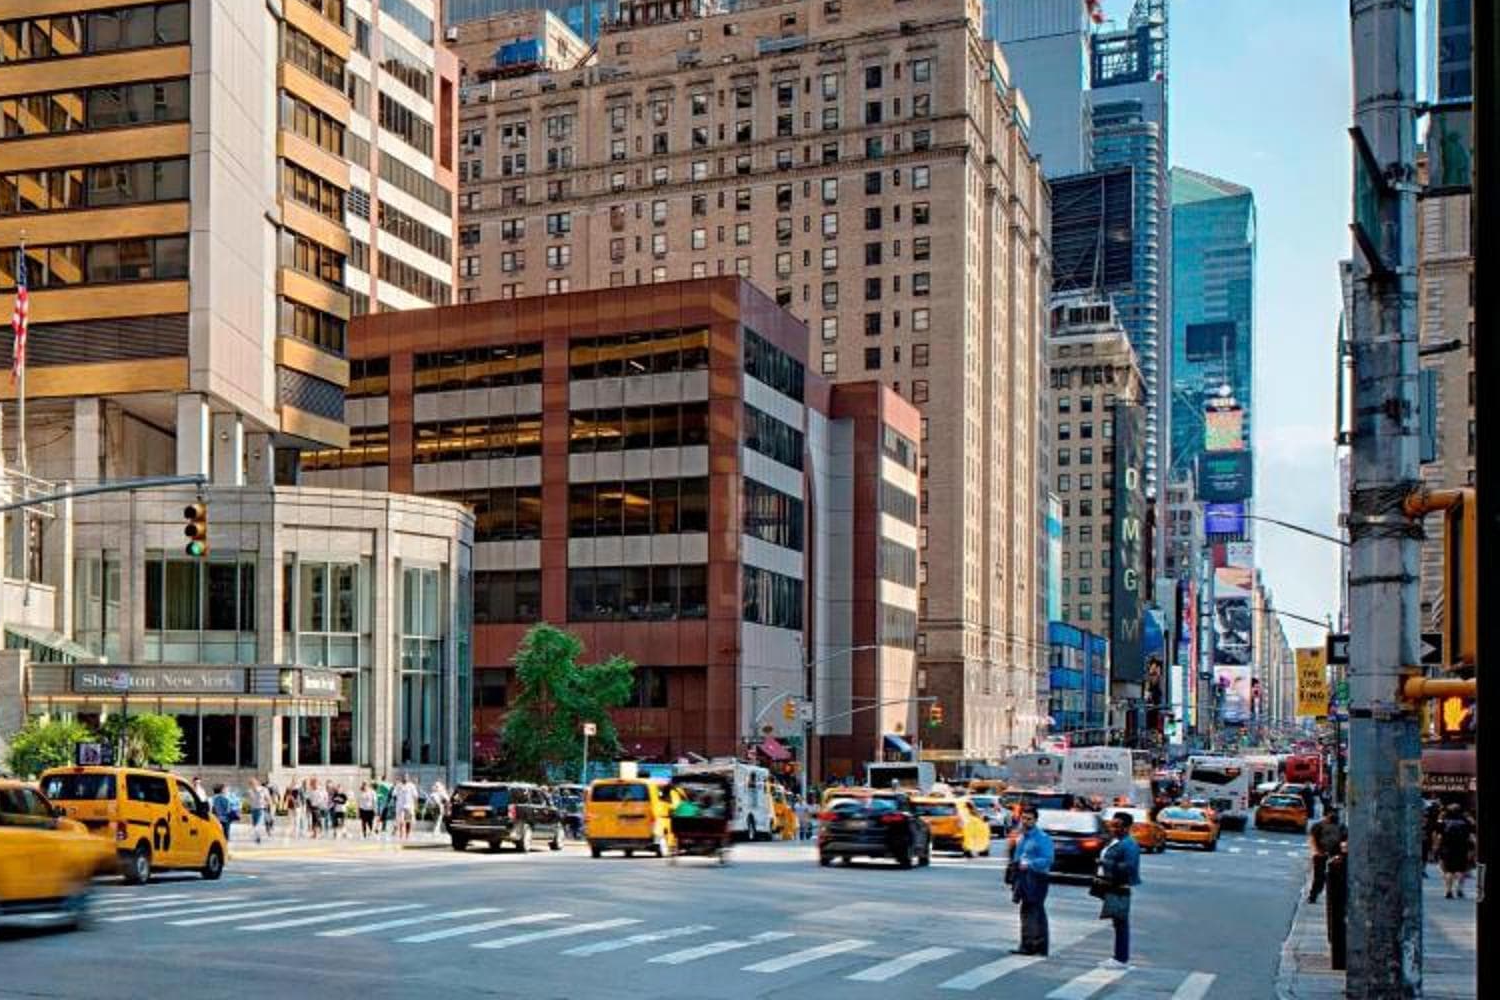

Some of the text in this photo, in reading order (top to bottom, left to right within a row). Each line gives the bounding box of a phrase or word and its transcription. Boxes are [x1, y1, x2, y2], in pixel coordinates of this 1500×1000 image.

[82, 672, 235, 688] Sheton New York
